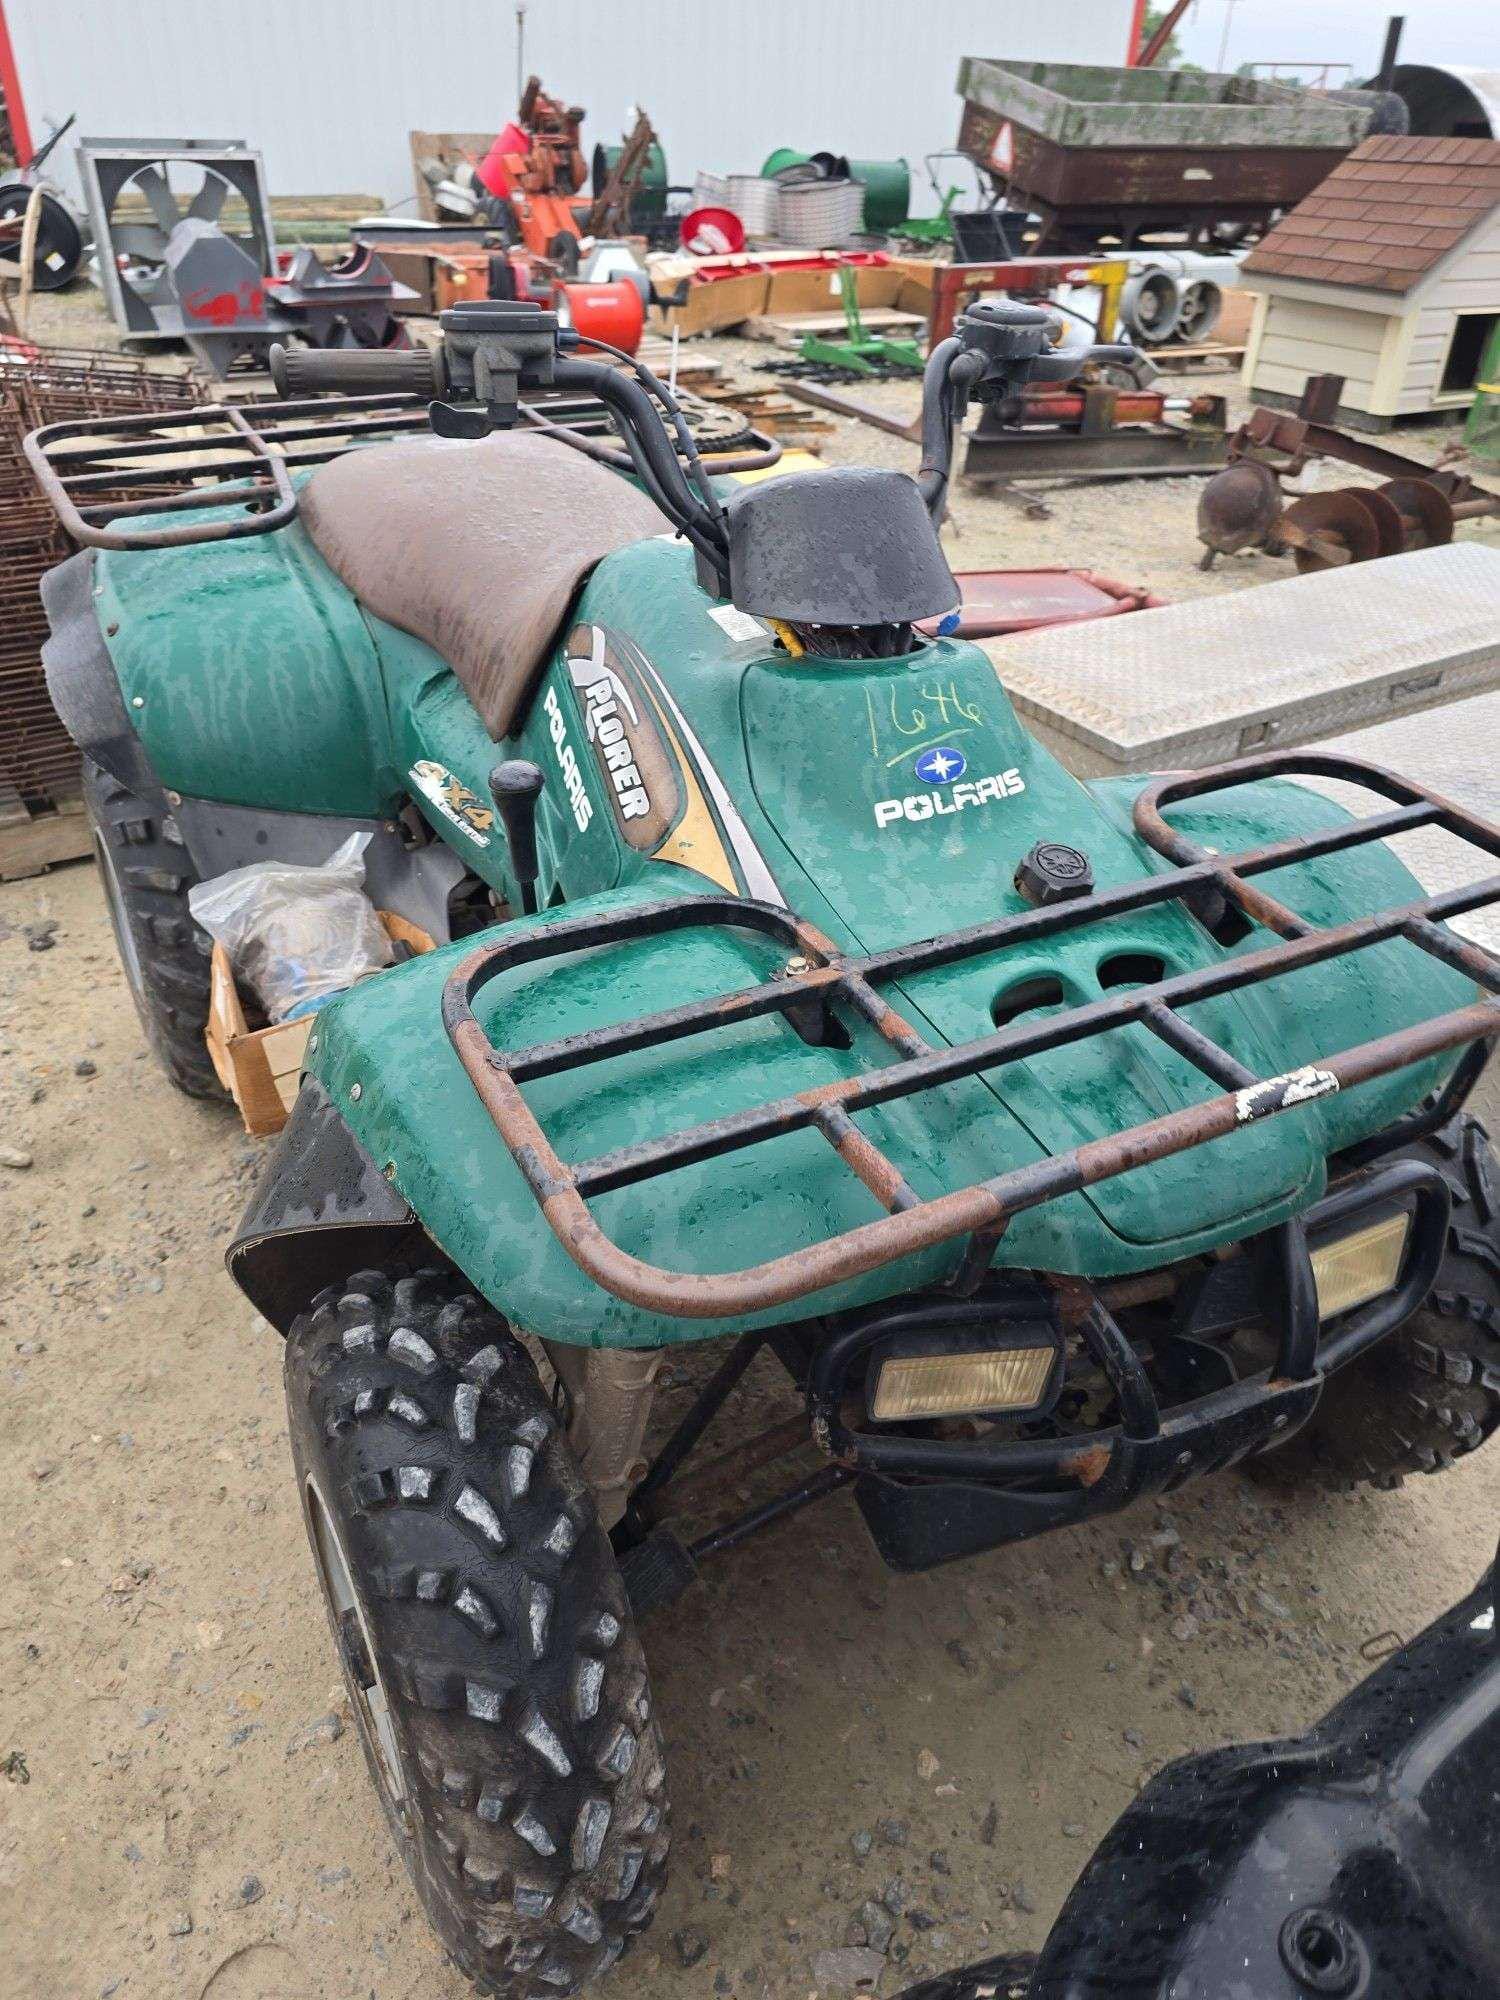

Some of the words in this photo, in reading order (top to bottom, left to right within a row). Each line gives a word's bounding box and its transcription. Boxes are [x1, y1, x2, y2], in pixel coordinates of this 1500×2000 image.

[863, 681, 984, 758] 1646
[543, 686, 594, 832] POLARIS
[874, 768, 1026, 828] POLARIS
